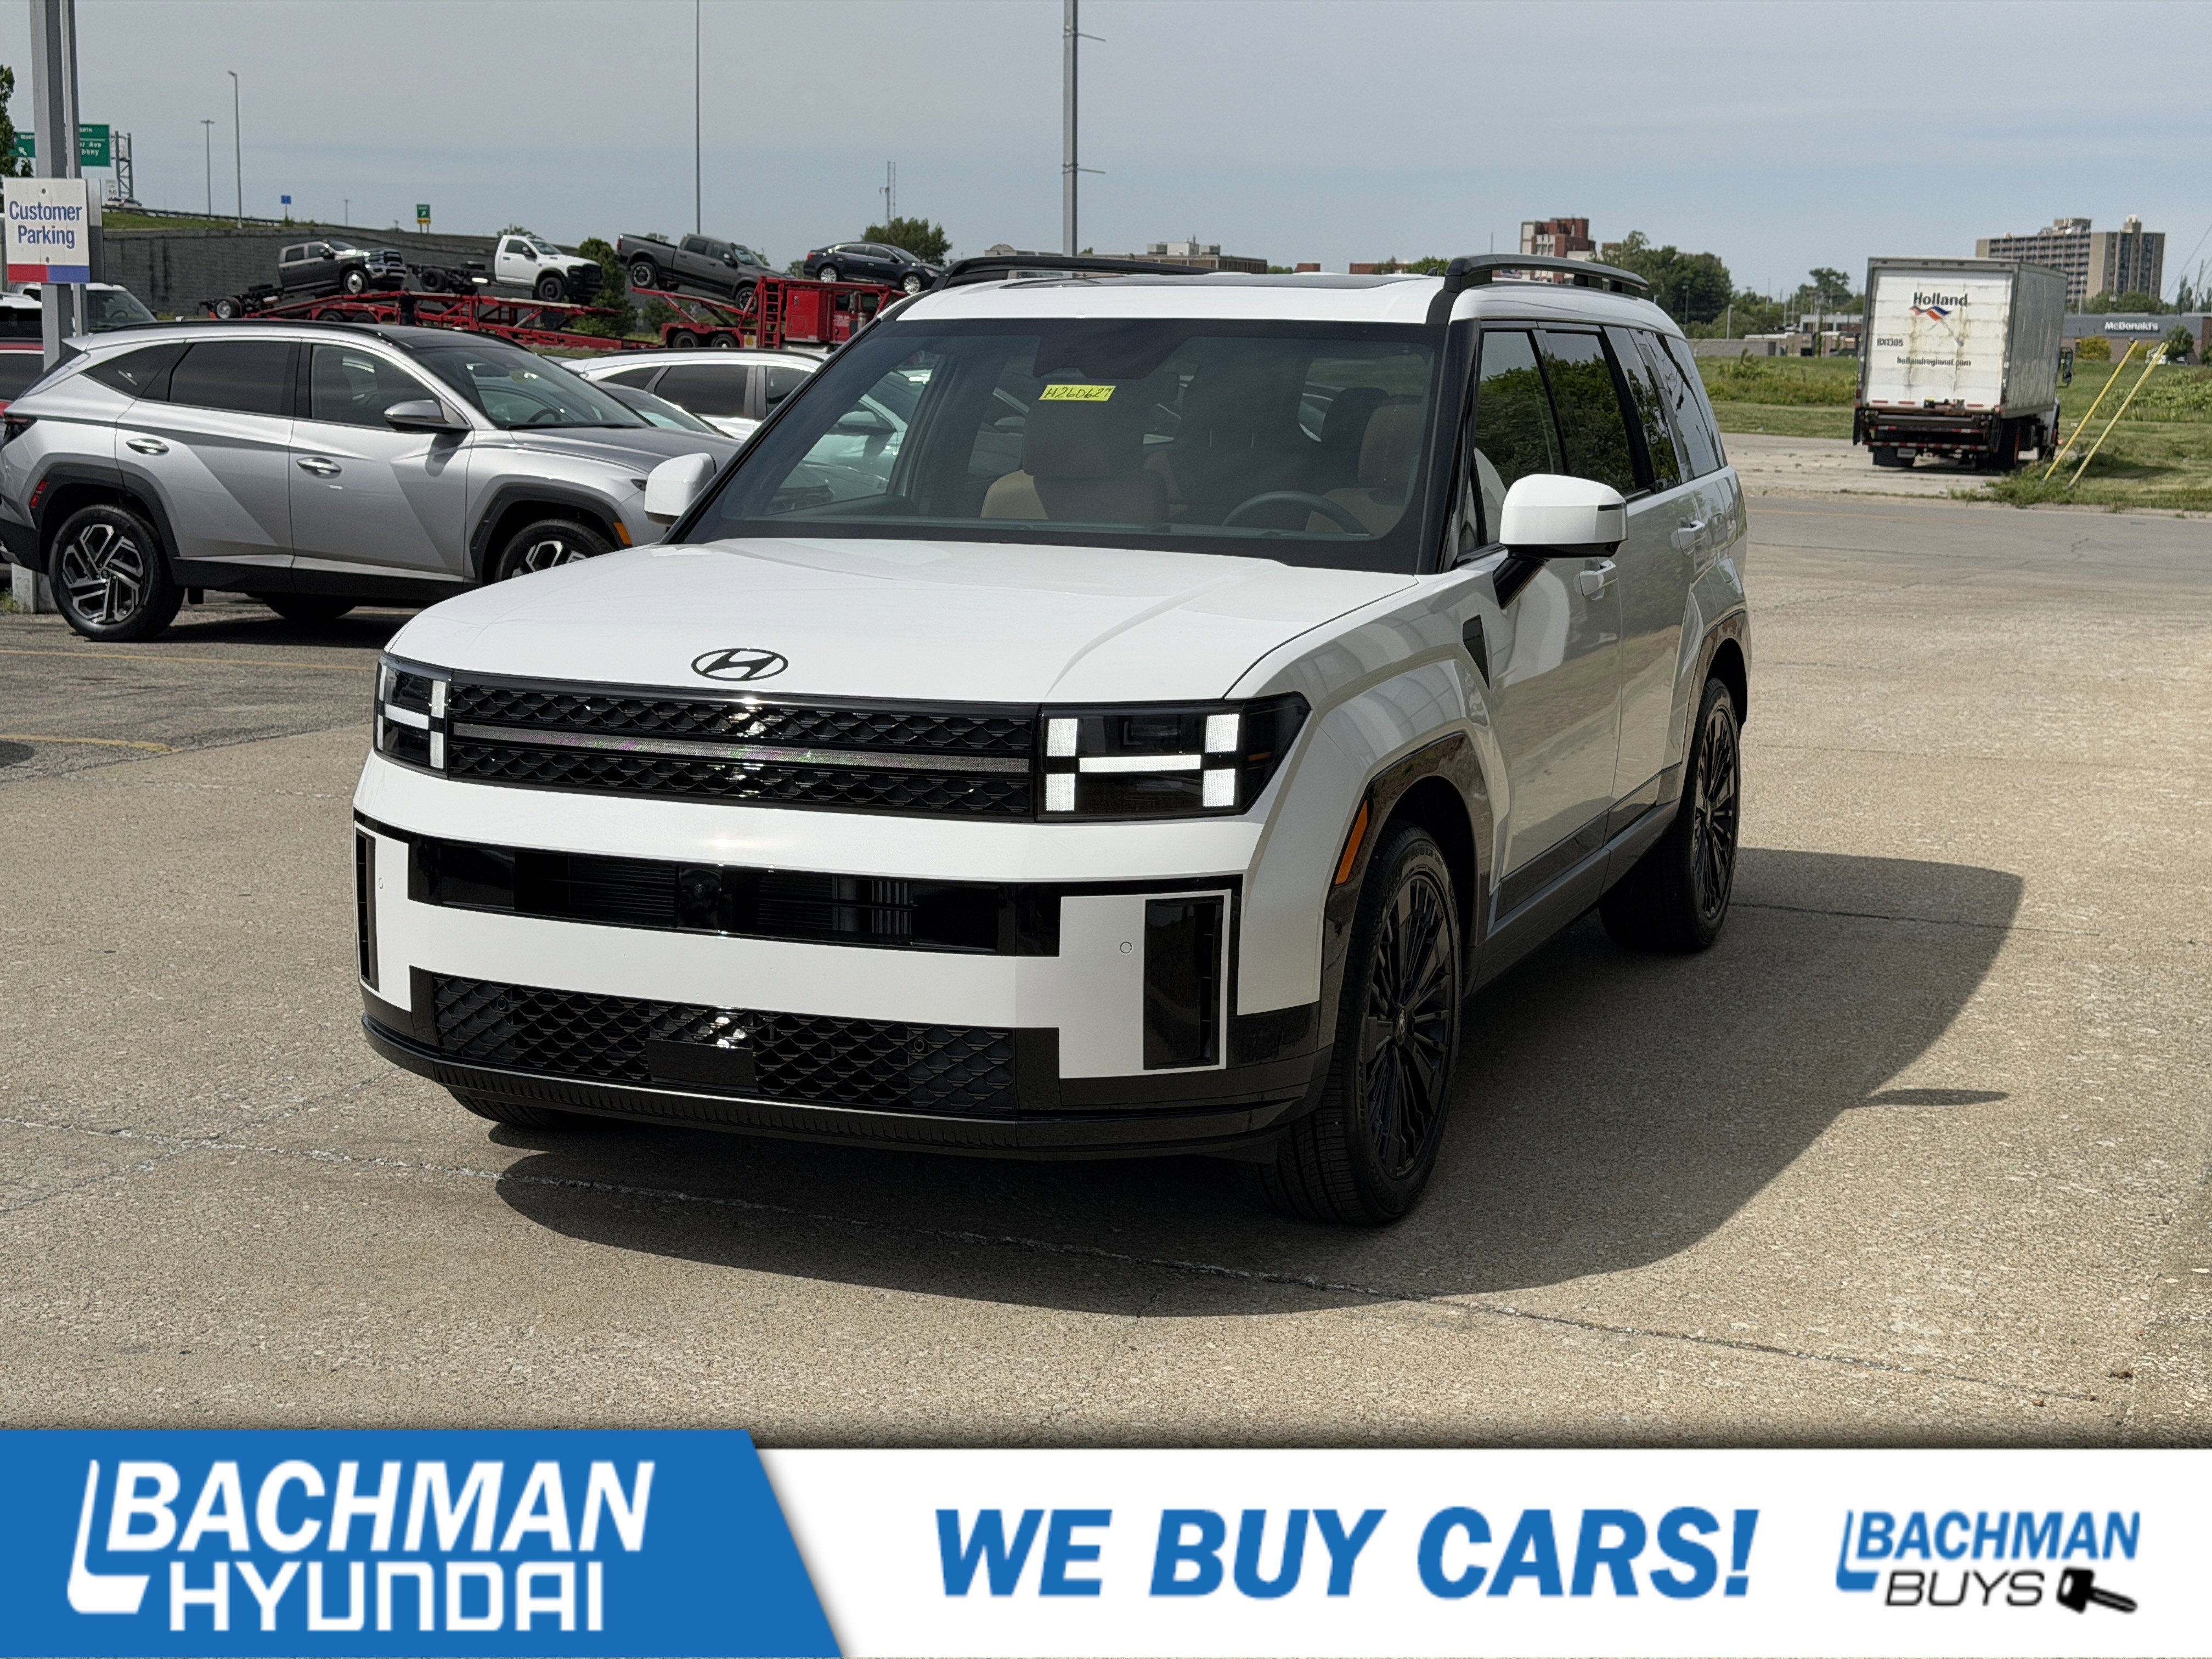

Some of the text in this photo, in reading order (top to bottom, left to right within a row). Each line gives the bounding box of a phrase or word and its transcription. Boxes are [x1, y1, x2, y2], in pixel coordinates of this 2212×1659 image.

[9, 200, 82, 221] Customer
[18, 224, 75, 249] Parking
[1913, 291, 1968, 306] Holland
